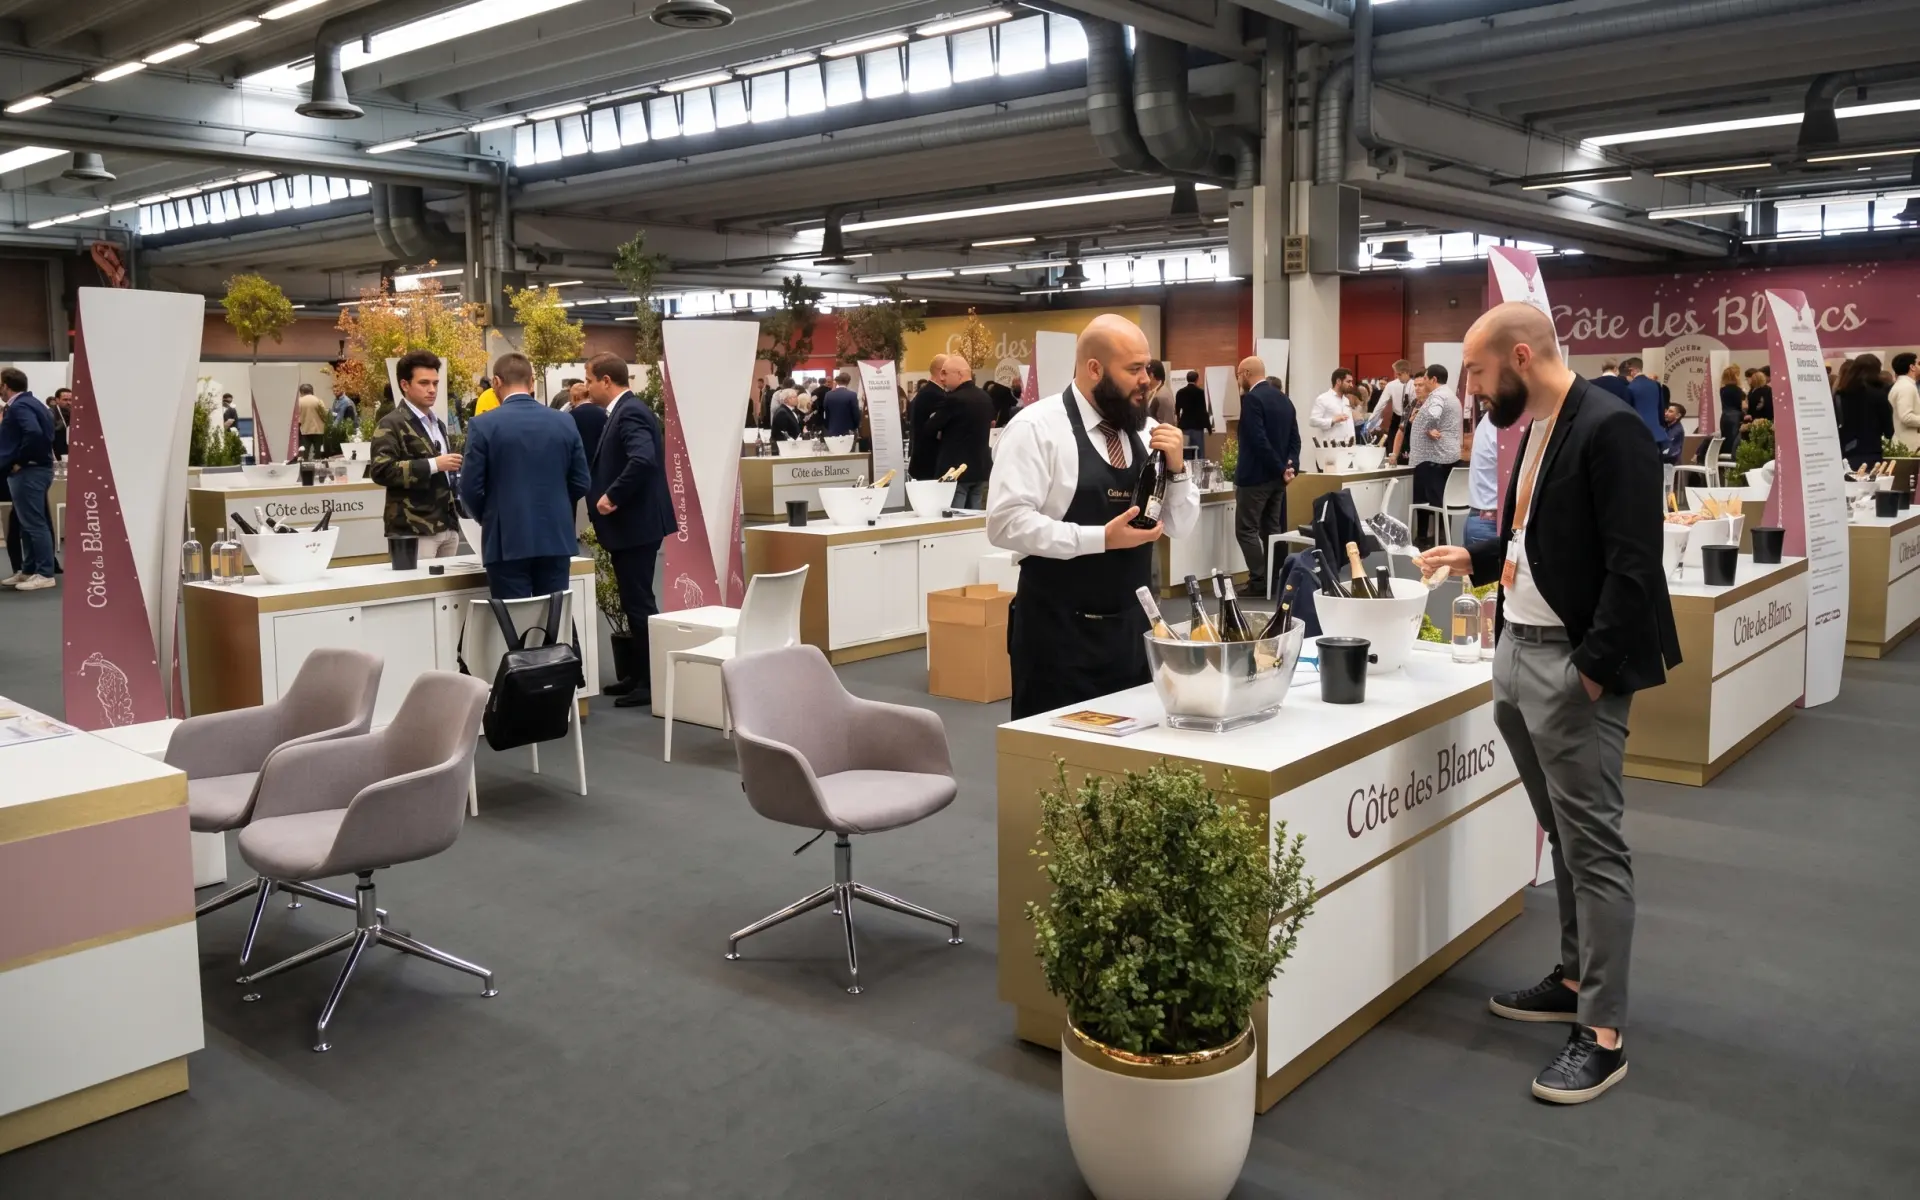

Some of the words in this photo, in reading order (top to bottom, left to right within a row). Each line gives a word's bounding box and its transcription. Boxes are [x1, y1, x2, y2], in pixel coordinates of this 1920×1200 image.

[1551, 304, 1630, 342] Côte
[1638, 302, 1706, 338] des
[995, 332, 1033, 359] des
[824, 465, 850, 476] Blancs
[80, 491, 103, 552] Blancs
[265, 502, 297, 517] Côte
[300, 502, 319, 515] des
[321, 499, 364, 514] Blancs
[87, 571, 107, 608] Côte
[1734, 615, 1754, 646] Côte
[1755, 610, 1767, 636] des
[1768, 600, 1792, 630] Blancs
[1347, 784, 1399, 838] Côte
[1404, 770, 1432, 811] des
[1437, 740, 1495, 794] Blancs
